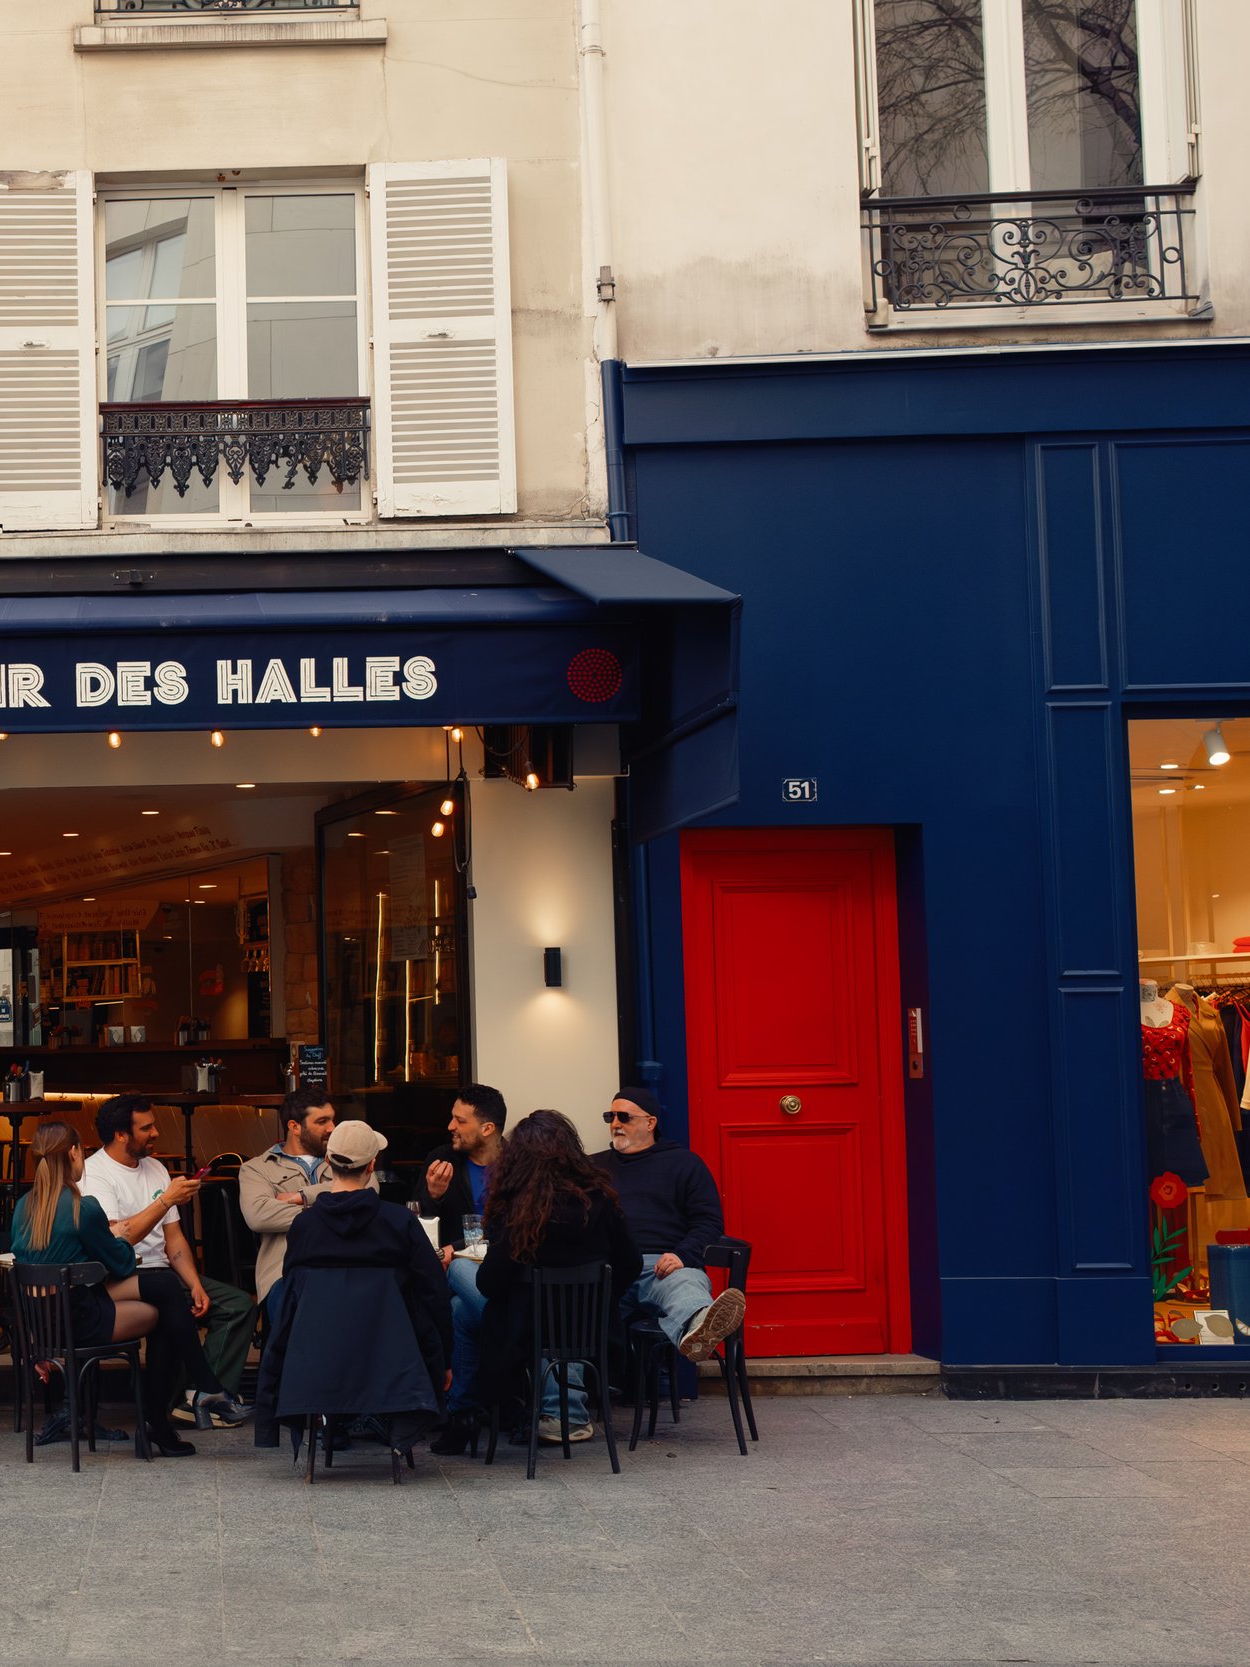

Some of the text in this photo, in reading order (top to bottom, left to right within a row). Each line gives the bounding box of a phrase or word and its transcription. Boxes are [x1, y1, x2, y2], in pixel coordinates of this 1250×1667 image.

[76, 661, 189, 708] DES
[216, 656, 438, 704] HALLES
[788, 781, 810, 799] 51
